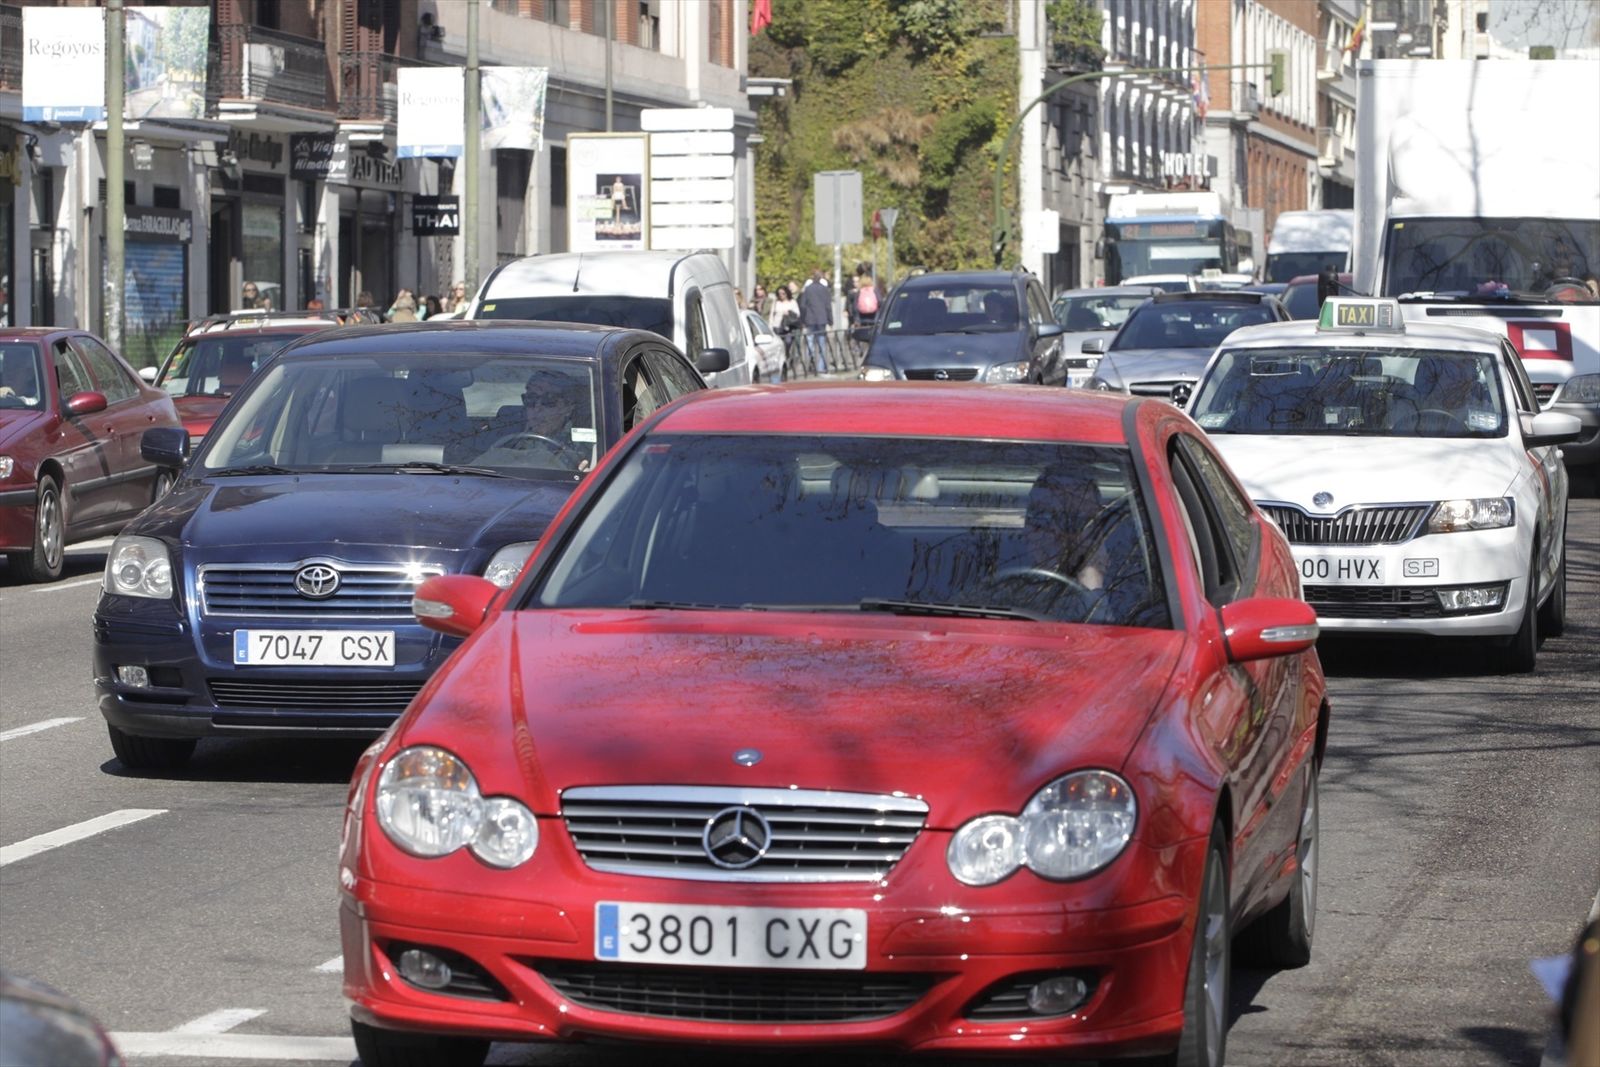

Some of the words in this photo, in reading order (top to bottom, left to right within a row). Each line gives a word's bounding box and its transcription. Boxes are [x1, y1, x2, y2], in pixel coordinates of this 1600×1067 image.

[29, 38, 101, 59] Regoyos
[312, 141, 346, 155] Viajes
[294, 158, 346, 173] Himalaya
[1164, 152, 1211, 177] HOTEL
[415, 213, 458, 228] THAI
[1340, 306, 1374, 324] TAXI
[1302, 558, 1329, 579] 00
[1338, 559, 1380, 579] HVX
[1407, 561, 1435, 575] SP
[259, 635, 323, 660] 7047
[341, 636, 388, 661] CSX
[629, 913, 738, 958] 3801
[765, 917, 853, 960] CXG
